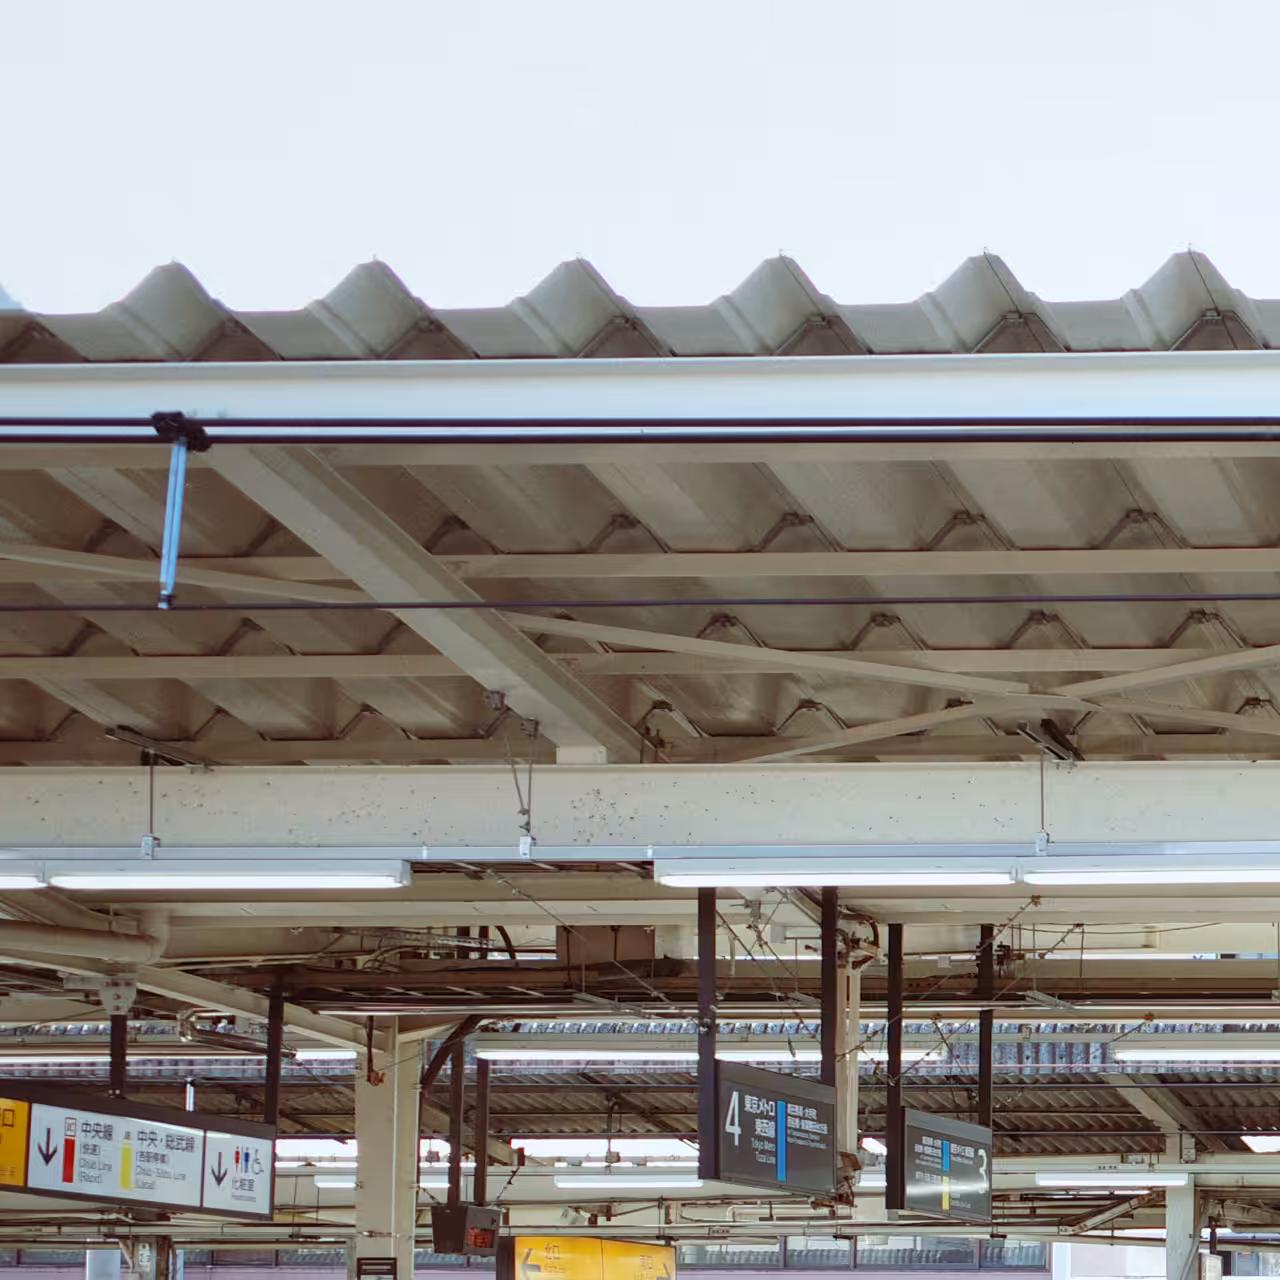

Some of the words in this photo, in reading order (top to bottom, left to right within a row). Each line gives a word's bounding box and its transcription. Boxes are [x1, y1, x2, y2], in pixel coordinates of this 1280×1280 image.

[81, 1121, 114, 1141] 中央線
[725, 1091, 742, 1146] 4
